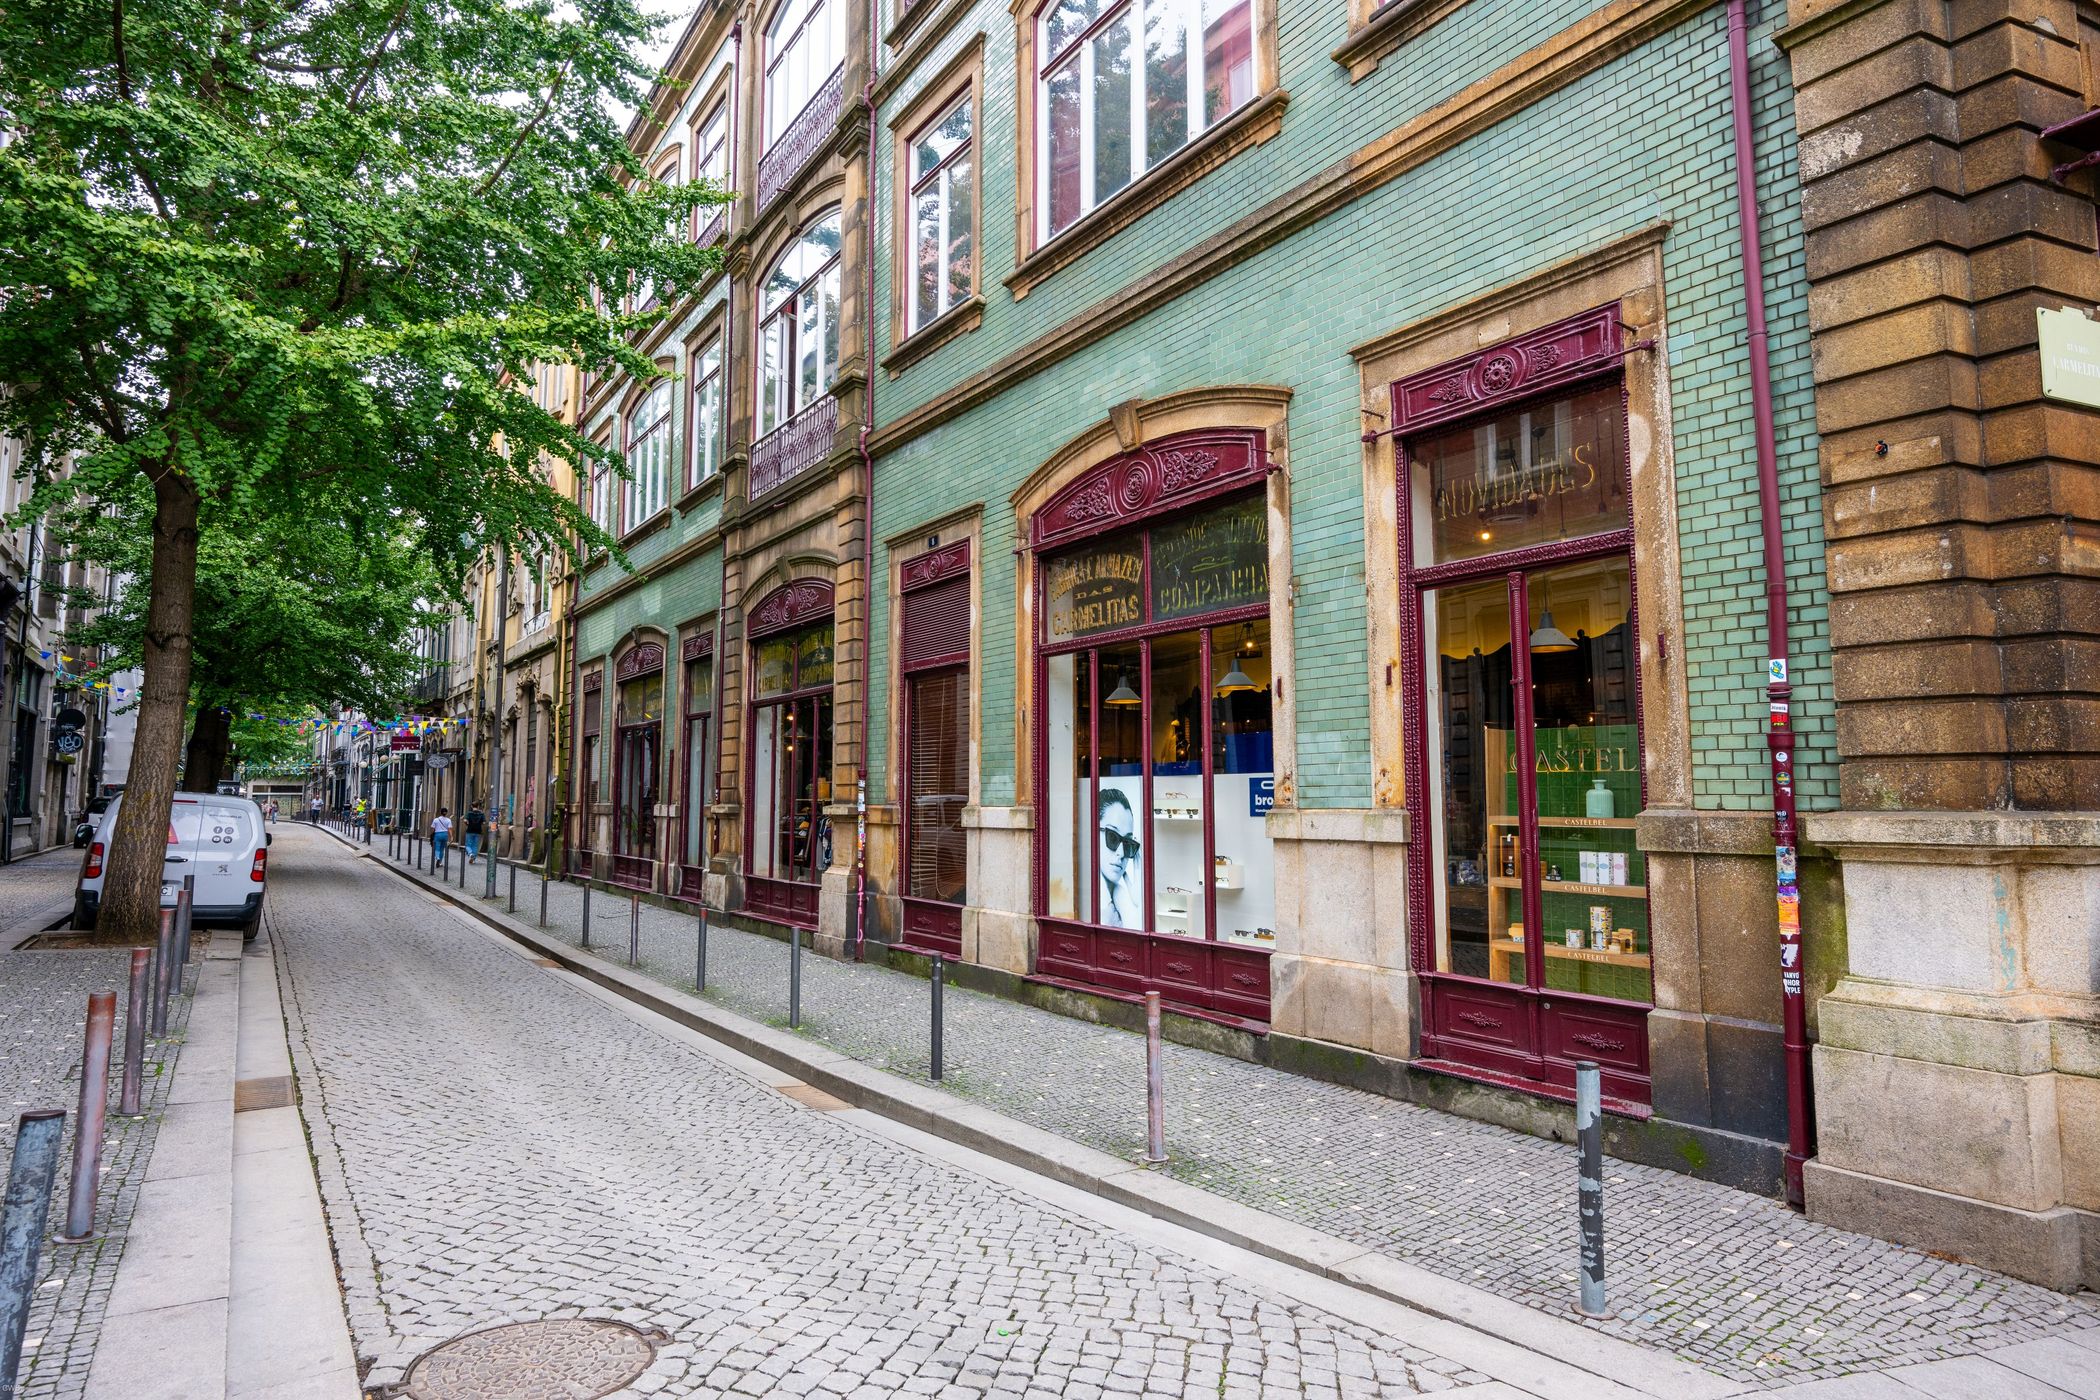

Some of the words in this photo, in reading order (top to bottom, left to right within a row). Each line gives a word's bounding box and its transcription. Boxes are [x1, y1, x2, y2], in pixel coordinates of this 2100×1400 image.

[1075, 585, 1113, 600] DAS
[1160, 562, 1269, 613] COMPANHIA
[1053, 594, 1139, 636] CARMELITAS
[1564, 818, 1608, 827] CASTELBEL
[1564, 884, 1607, 894] CASTELBEL
[1567, 951, 1609, 962] CASTELBEL
